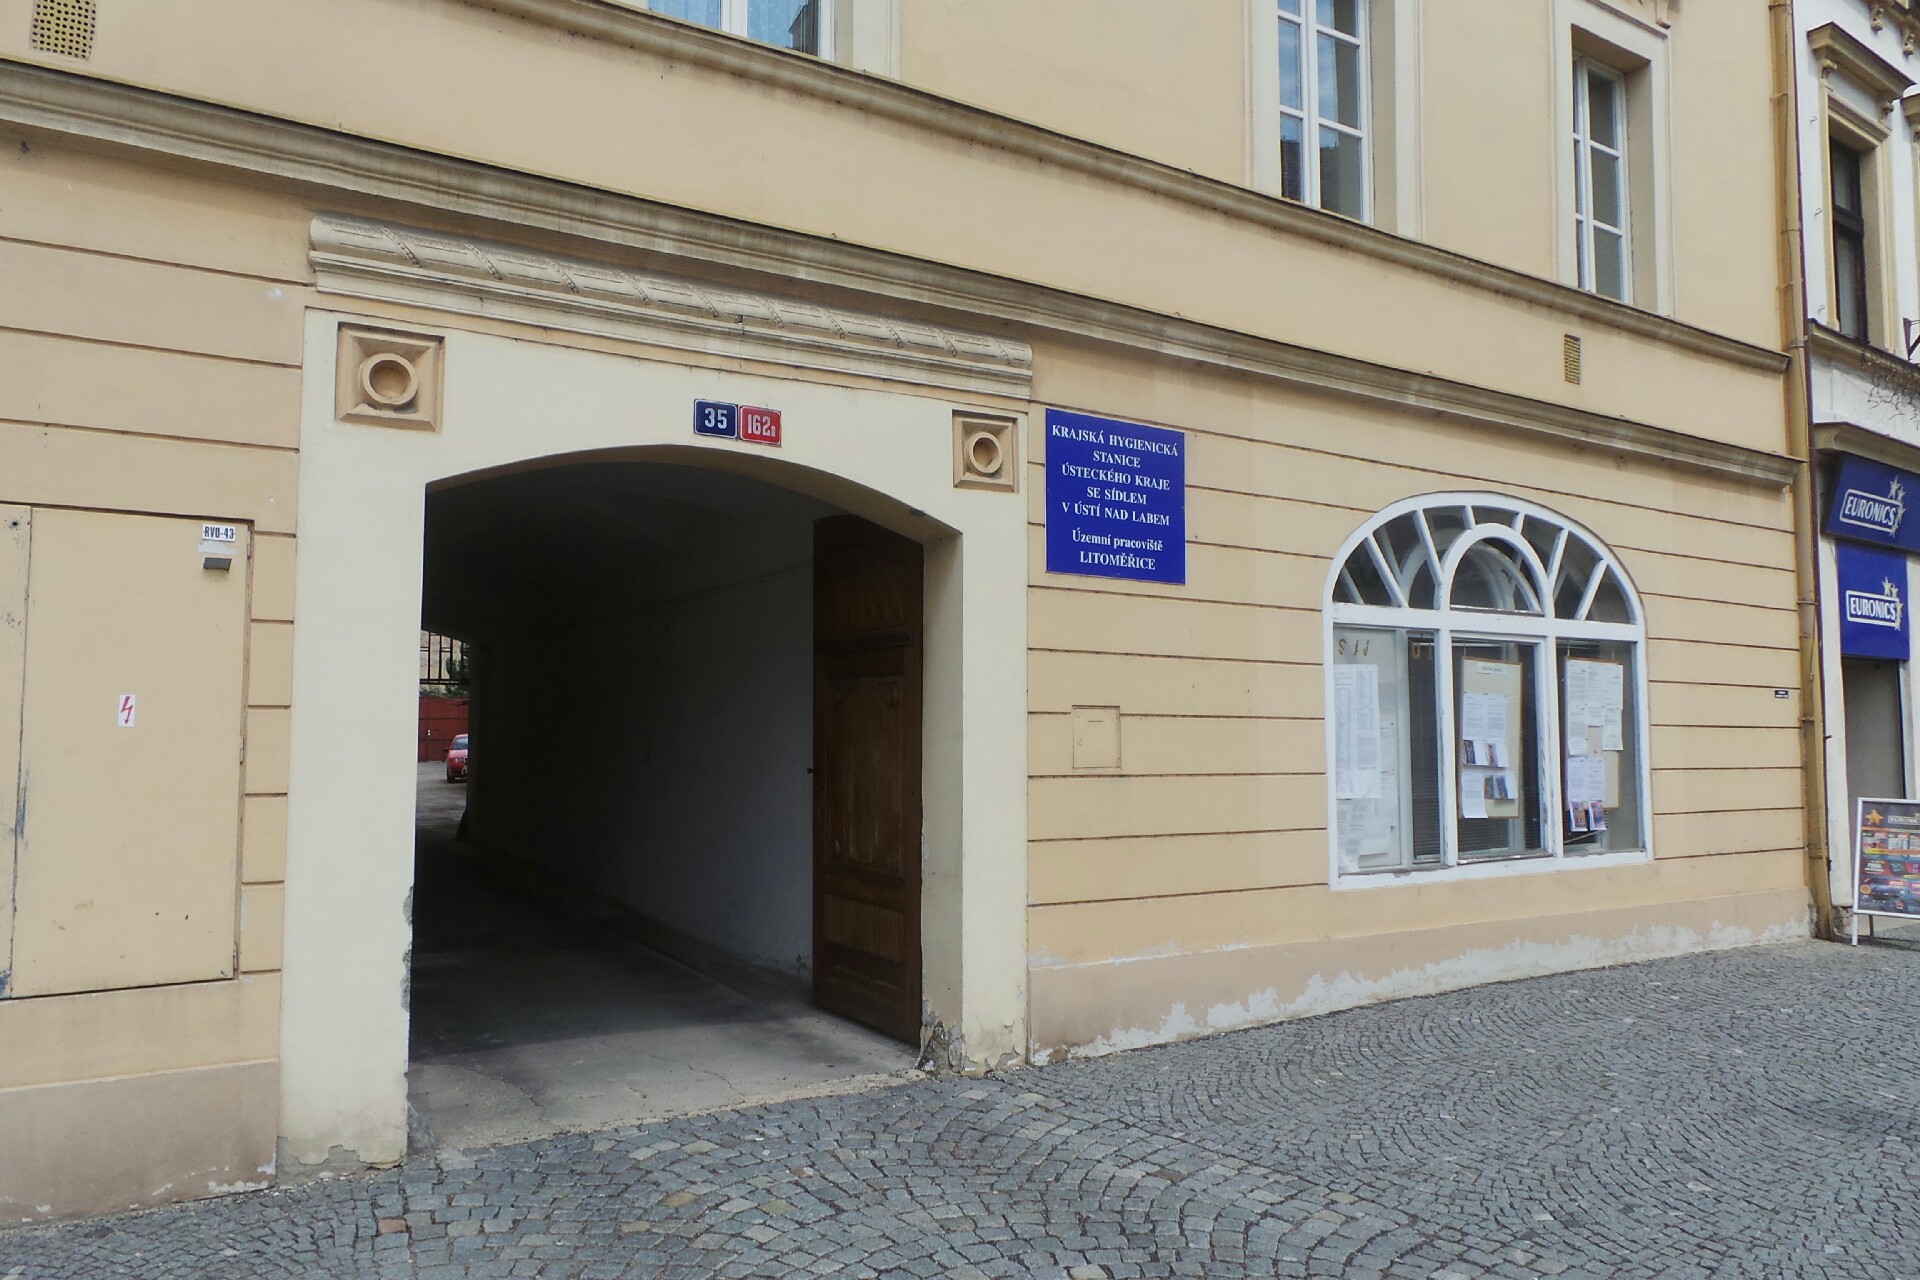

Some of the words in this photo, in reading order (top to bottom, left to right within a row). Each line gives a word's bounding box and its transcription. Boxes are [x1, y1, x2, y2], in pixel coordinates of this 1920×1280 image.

[704, 408, 727, 429] 35
[1052, 425, 1104, 444] KRAJSKÁ
[1109, 435, 1178, 456] HYGIENICKÁ
[1093, 451, 1141, 468] STANICE
[1062, 463, 1131, 485] ÚSTECKÉHO
[1135, 475, 1170, 490] KRAJE
[1087, 487, 1100, 498] SE
[1105, 487, 1147, 505] SÍDLEM
[1062, 502, 1070, 513] V
[1074, 501, 1100, 517] ÚSTÍ
[1105, 507, 1128, 520] NAD
[1132, 511, 1170, 526] LABEM
[1844, 496, 1897, 526] EURONICS
[1072, 527, 1111, 546] Územní
[1114, 538, 1163, 551] pracoviště
[1080, 551, 1156, 570] LITOMĚŘICE
[1850, 597, 1896, 620] EURONICS
